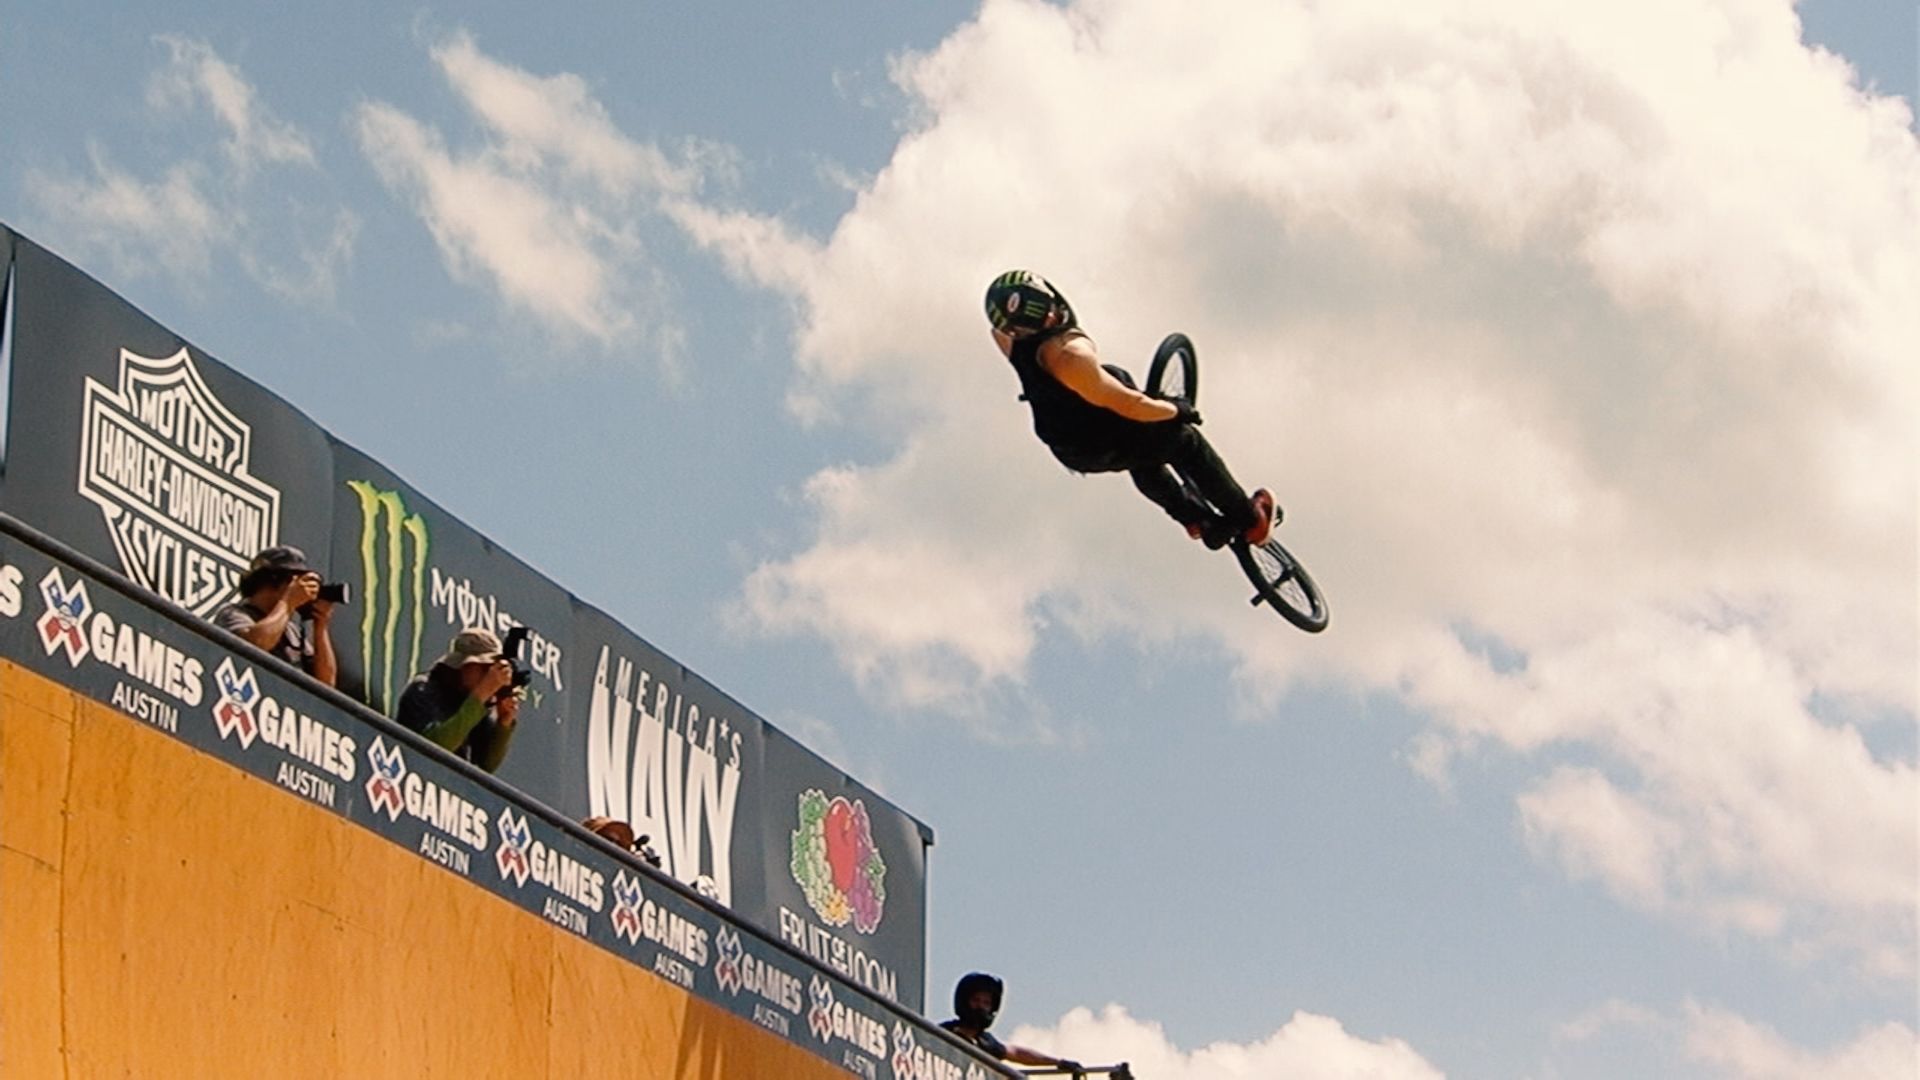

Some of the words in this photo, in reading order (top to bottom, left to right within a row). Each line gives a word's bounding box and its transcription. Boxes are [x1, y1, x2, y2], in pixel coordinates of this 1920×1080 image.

[140, 384, 226, 470] MOTOR
[98, 419, 261, 557] HARLEY-DAVIDSON
[131, 516, 218, 607] CYCLES
[91, 611, 205, 708] GAMES
[111, 681, 179, 734] AUSTIN
[258, 696, 357, 782] GAMES
[276, 760, 336, 808] AUSTIN
[404, 772, 489, 851] GAMES
[587, 682, 742, 910] NAVY
[420, 831, 471, 875] AUSTIN
[529, 840, 605, 913] GAMES
[543, 896, 589, 936] AUSTIN
[641, 899, 709, 968] GAMES
[780, 906, 831, 963] FRUIT
[654, 952, 695, 990] AUSTIN
[741, 952, 803, 1016] GAMES
[832, 1000, 887, 1060] GAMES
